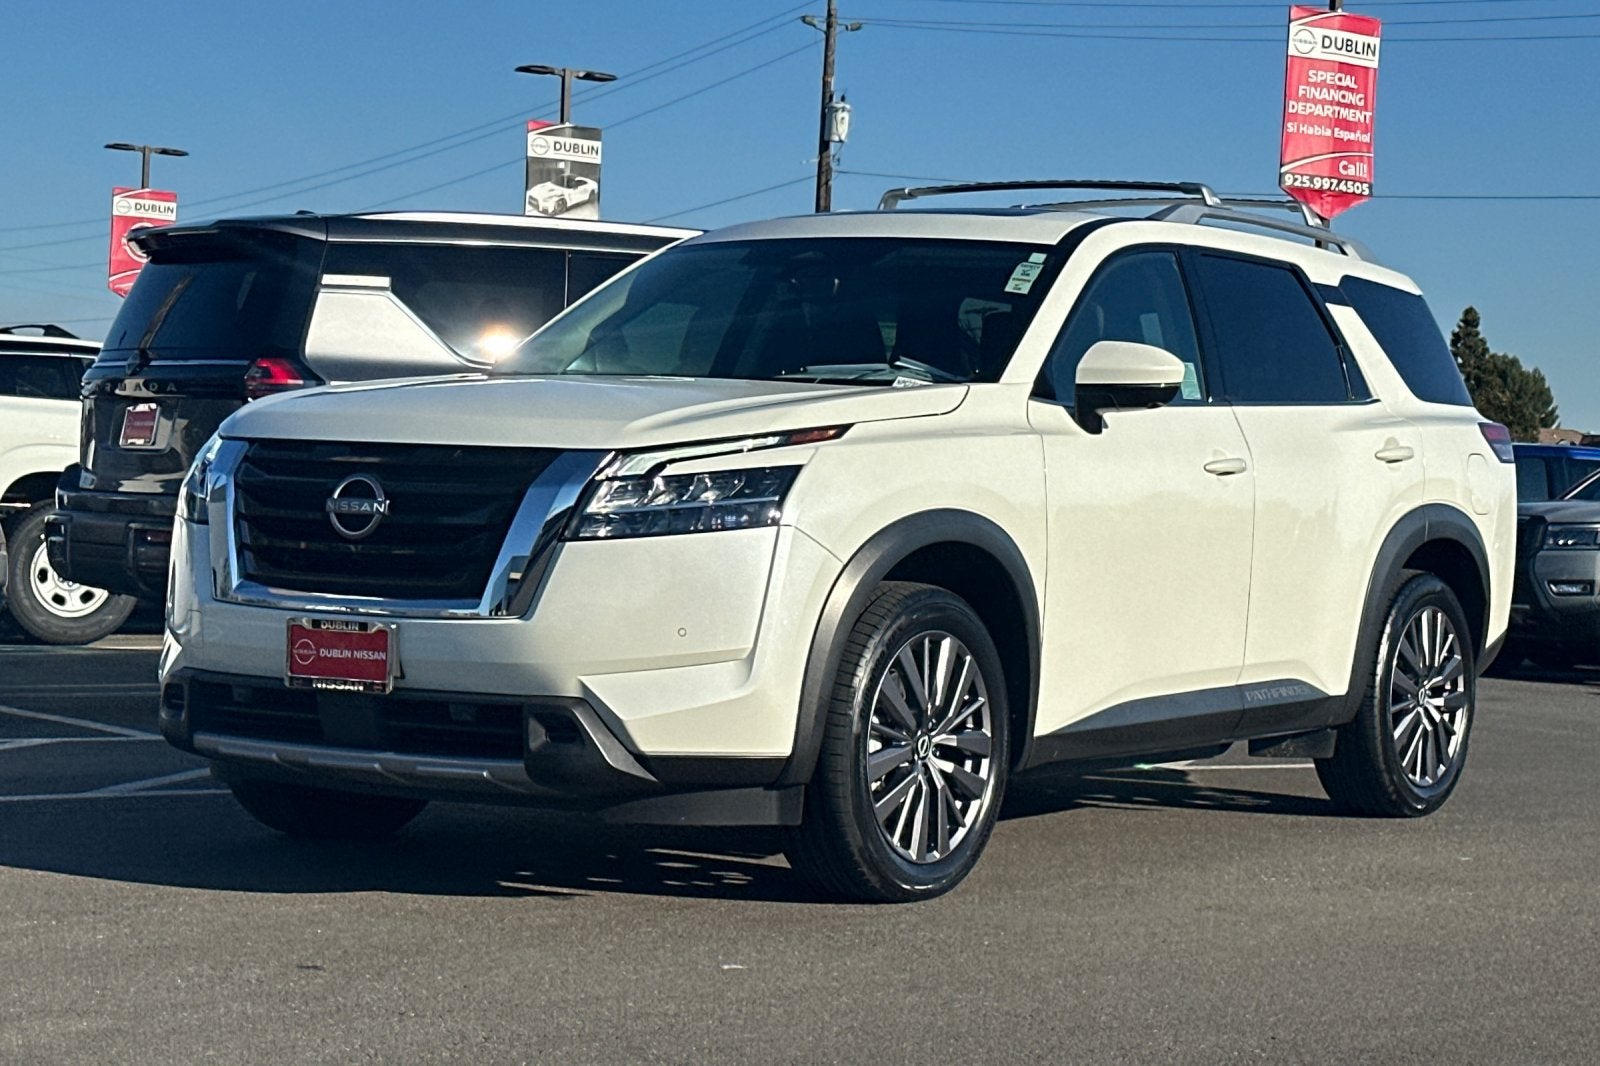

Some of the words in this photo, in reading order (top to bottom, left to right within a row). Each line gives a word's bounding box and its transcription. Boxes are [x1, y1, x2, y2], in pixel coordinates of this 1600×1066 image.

[1321, 35, 1376, 57] DUBLIN
[1308, 69, 1358, 89] SPECIAL
[1298, 84, 1365, 106] FINANCING
[1288, 100, 1372, 124] DEPARTMENT
[553, 141, 599, 156] DUBLIN
[1339, 160, 1369, 178] Call!
[1284, 173, 1370, 196] 925.997.4505
[134, 202, 174, 214] DUBLIN
[326, 500, 385, 513] NISSAN
[320, 619, 359, 631] DUBLIN
[320, 648, 352, 659] DUBLIN
[353, 650, 386, 661] NISSAN
